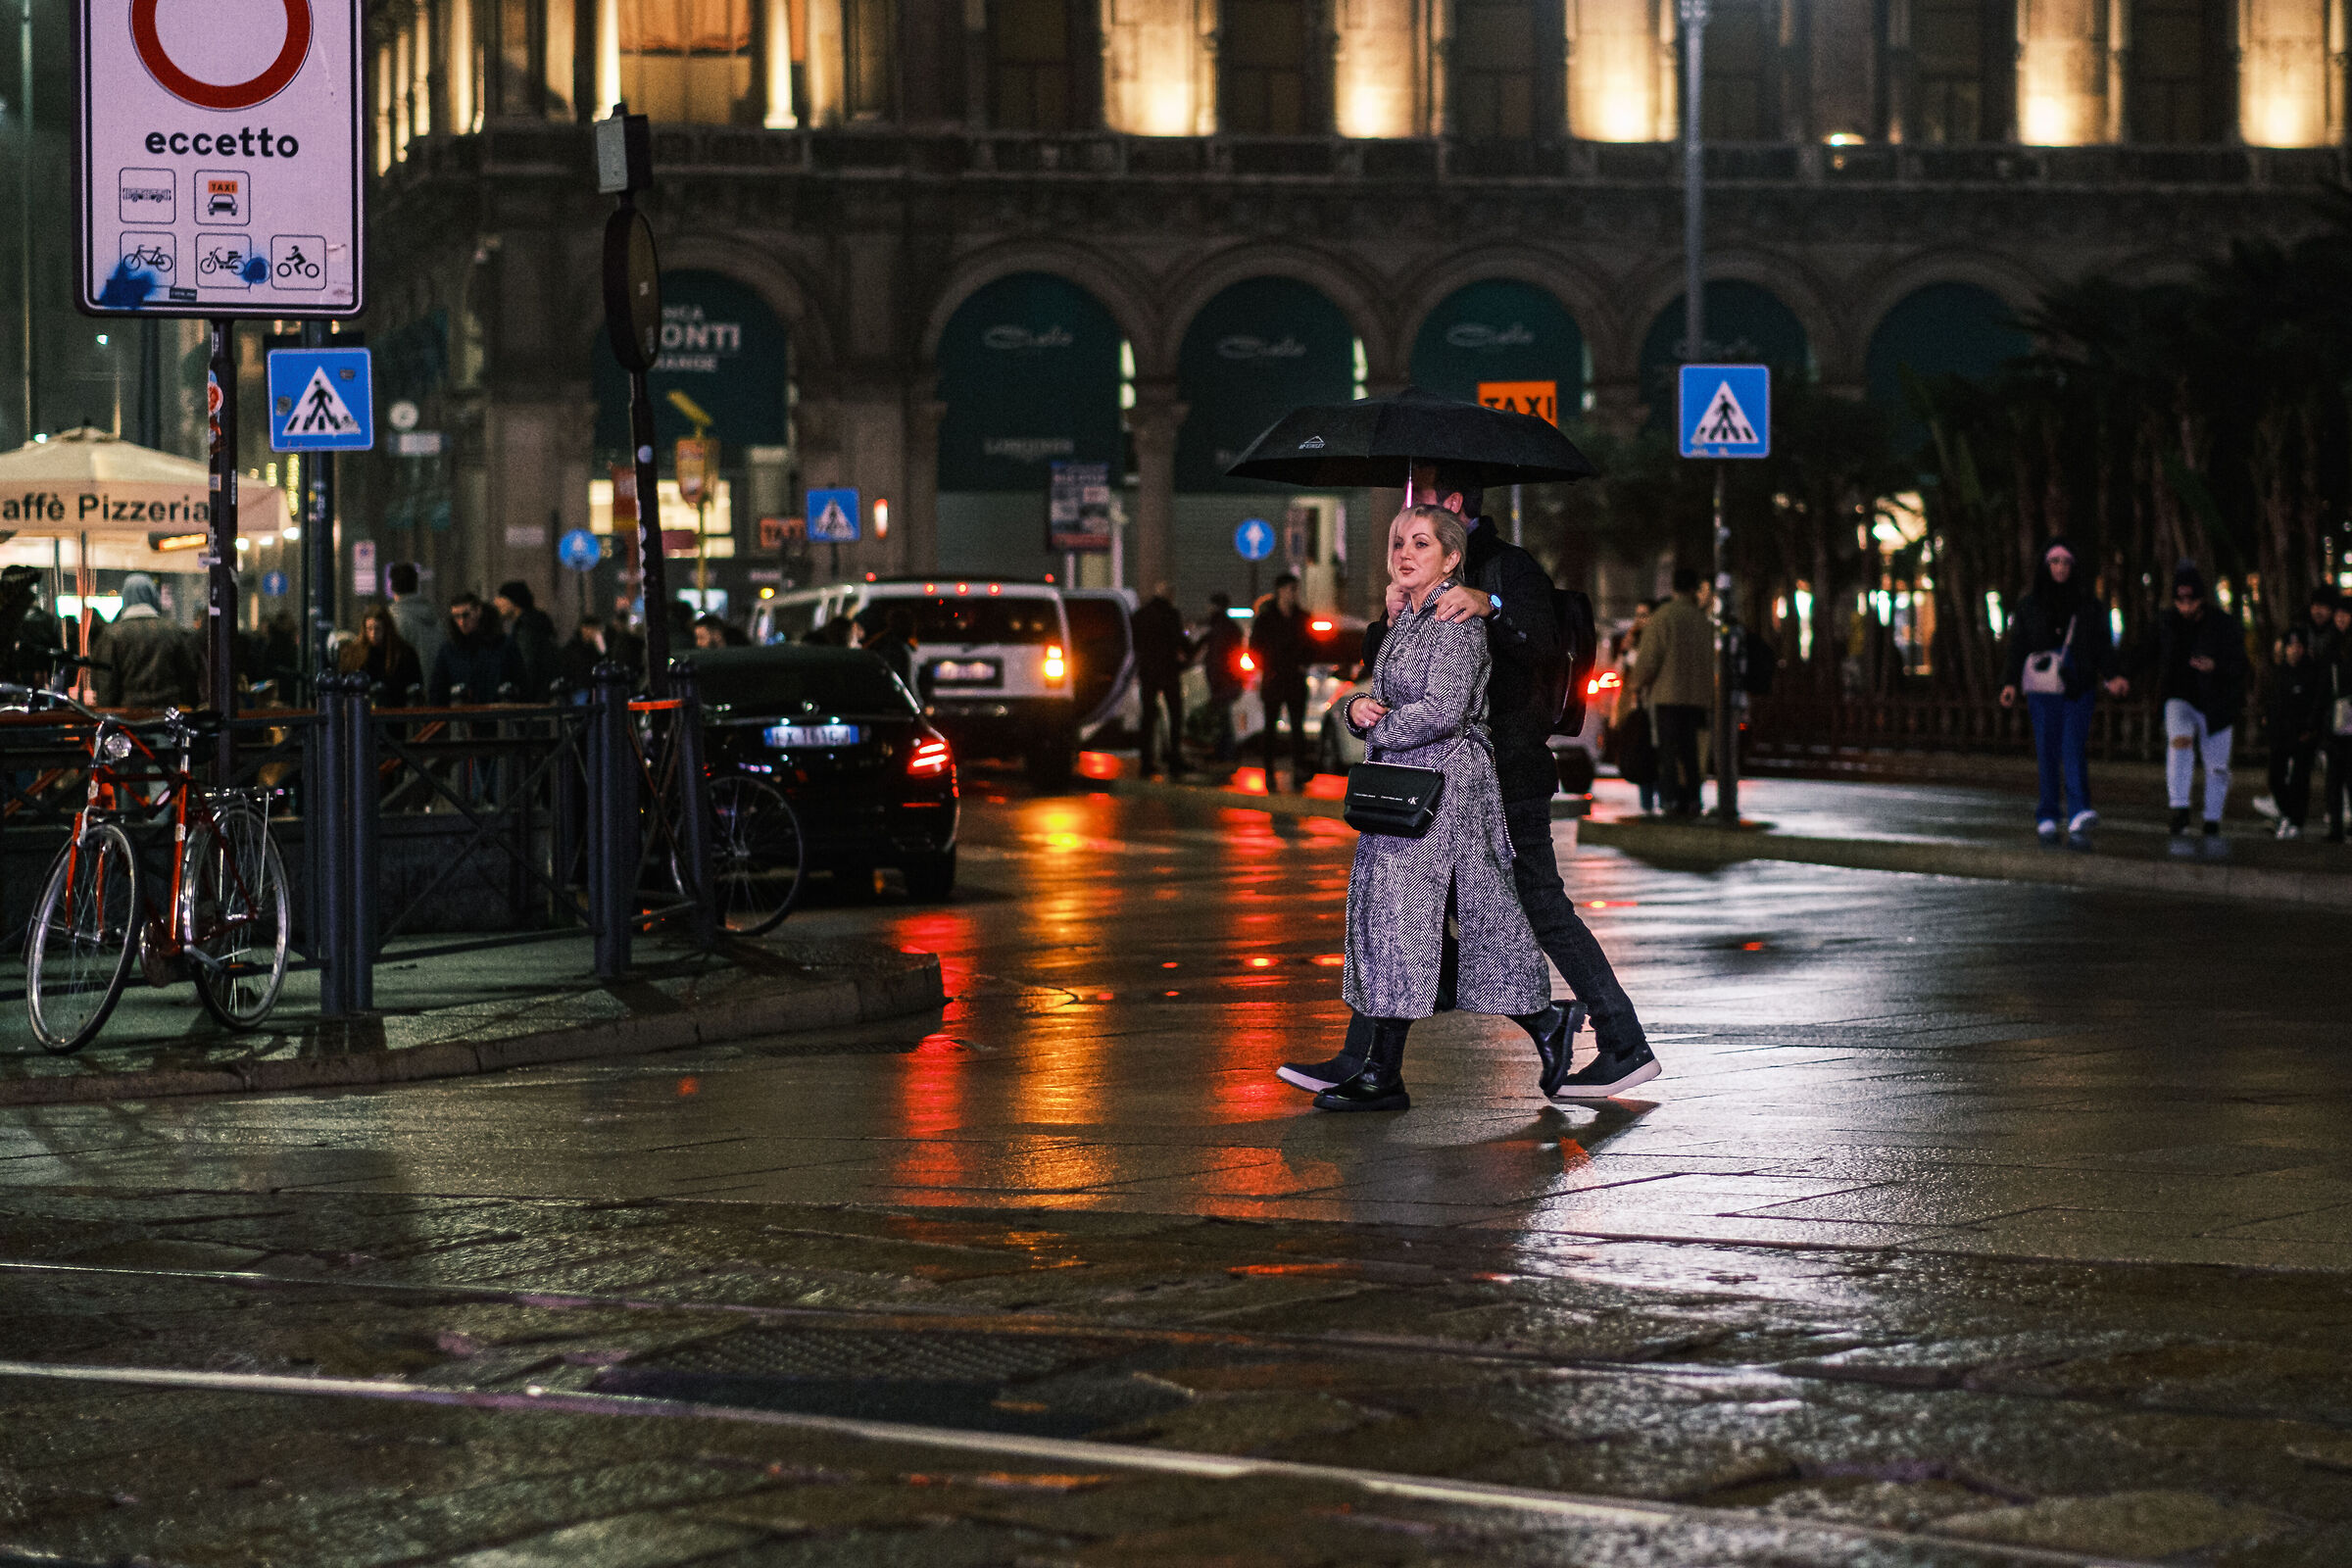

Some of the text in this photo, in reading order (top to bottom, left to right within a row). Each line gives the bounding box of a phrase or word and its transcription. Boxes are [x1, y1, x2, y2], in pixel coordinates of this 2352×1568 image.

[145, 126, 299, 159] eccetto
[212, 183, 234, 193] TAXI
[661, 323, 742, 349] ONTI
[1484, 396, 1552, 419] TAXI
[2, 493, 210, 522] affè Pizzeria
